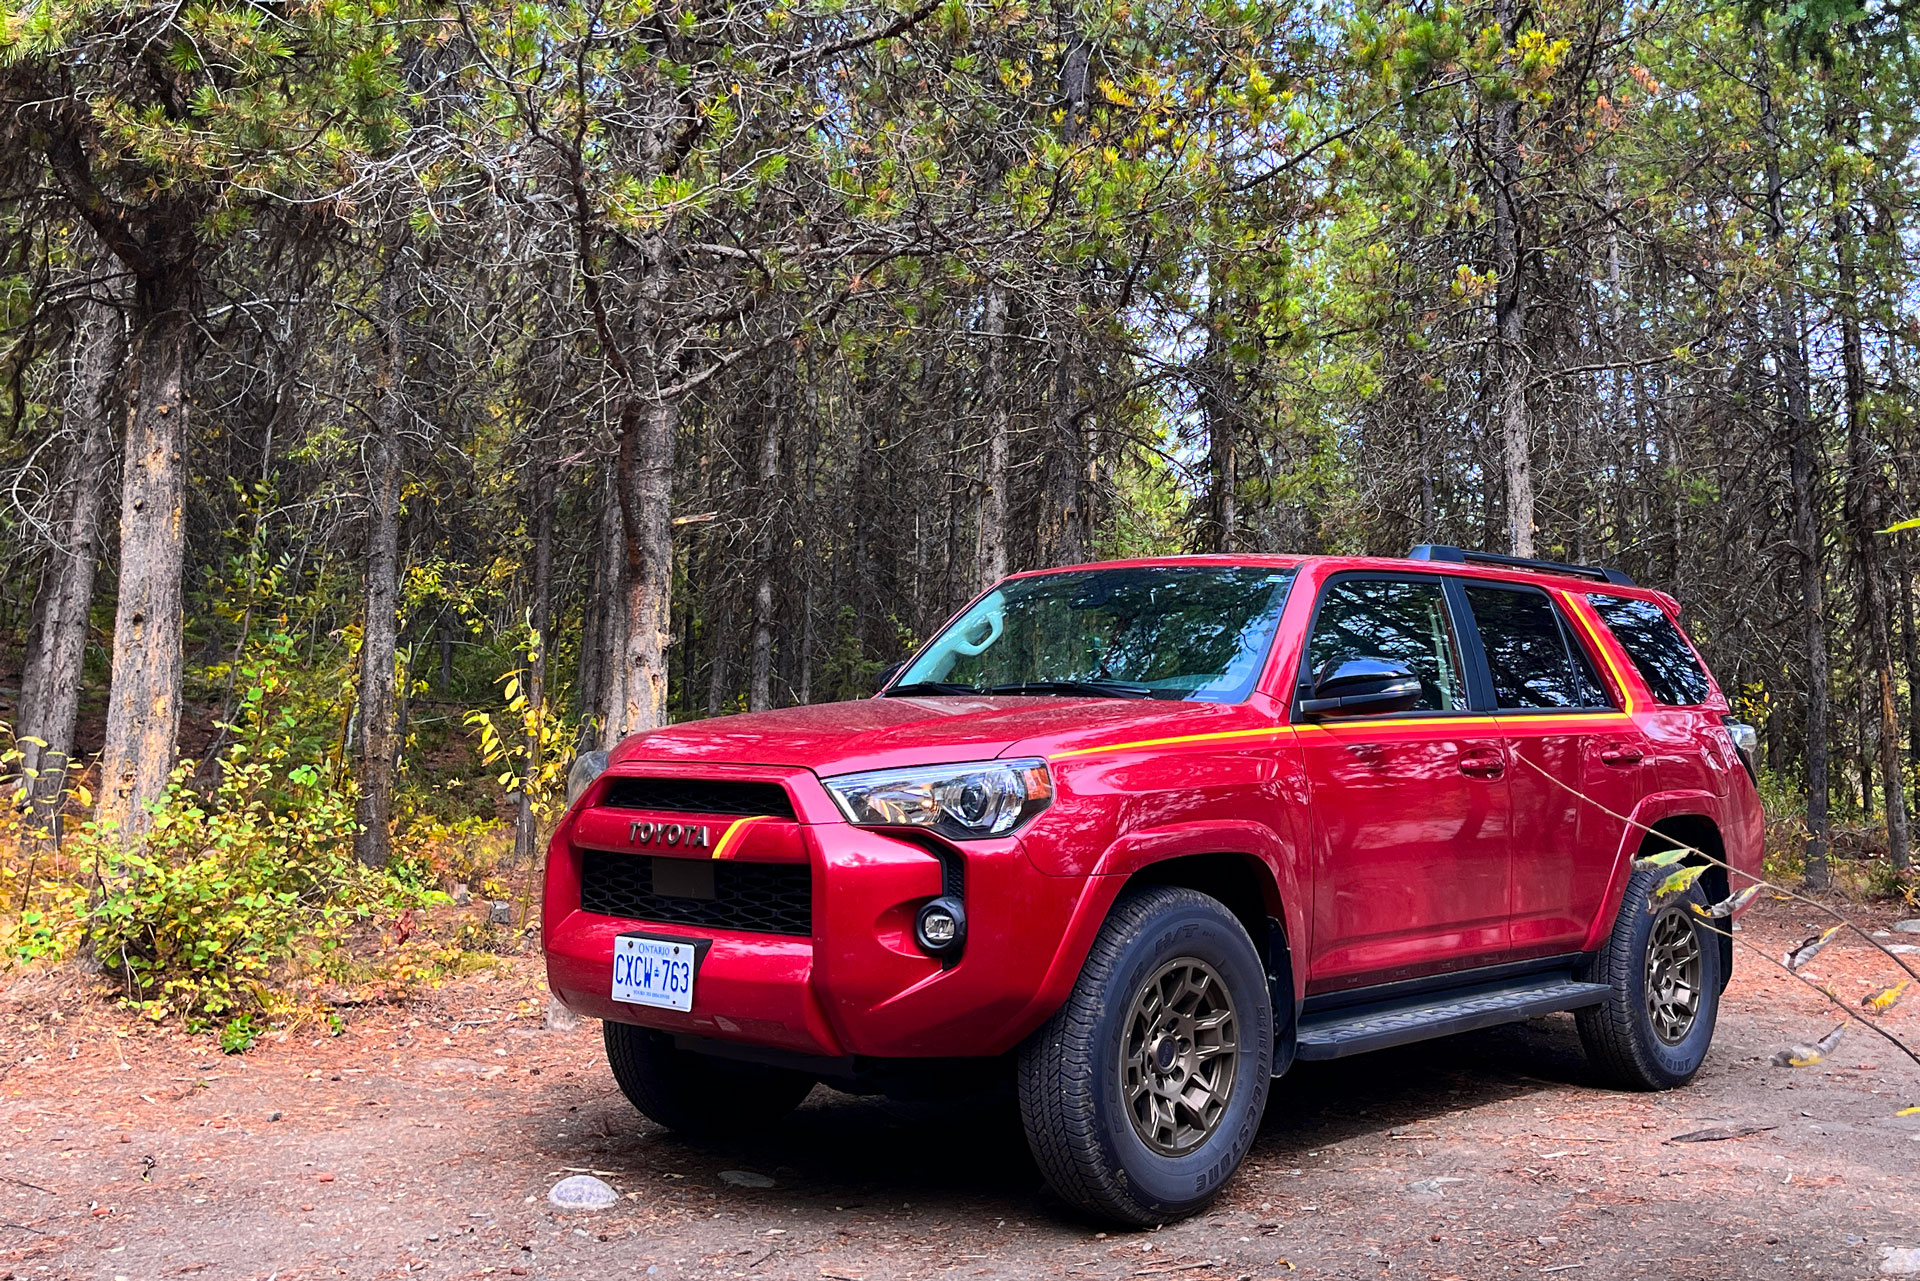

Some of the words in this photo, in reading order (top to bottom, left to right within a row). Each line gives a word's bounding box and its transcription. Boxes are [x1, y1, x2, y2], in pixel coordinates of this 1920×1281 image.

[630, 822, 710, 846] TOYOTA
[638, 943, 670, 956] ONTARIO
[1155, 923, 1200, 955] H/T
[615, 953, 653, 989] CXCW
[662, 959, 690, 994] 763
